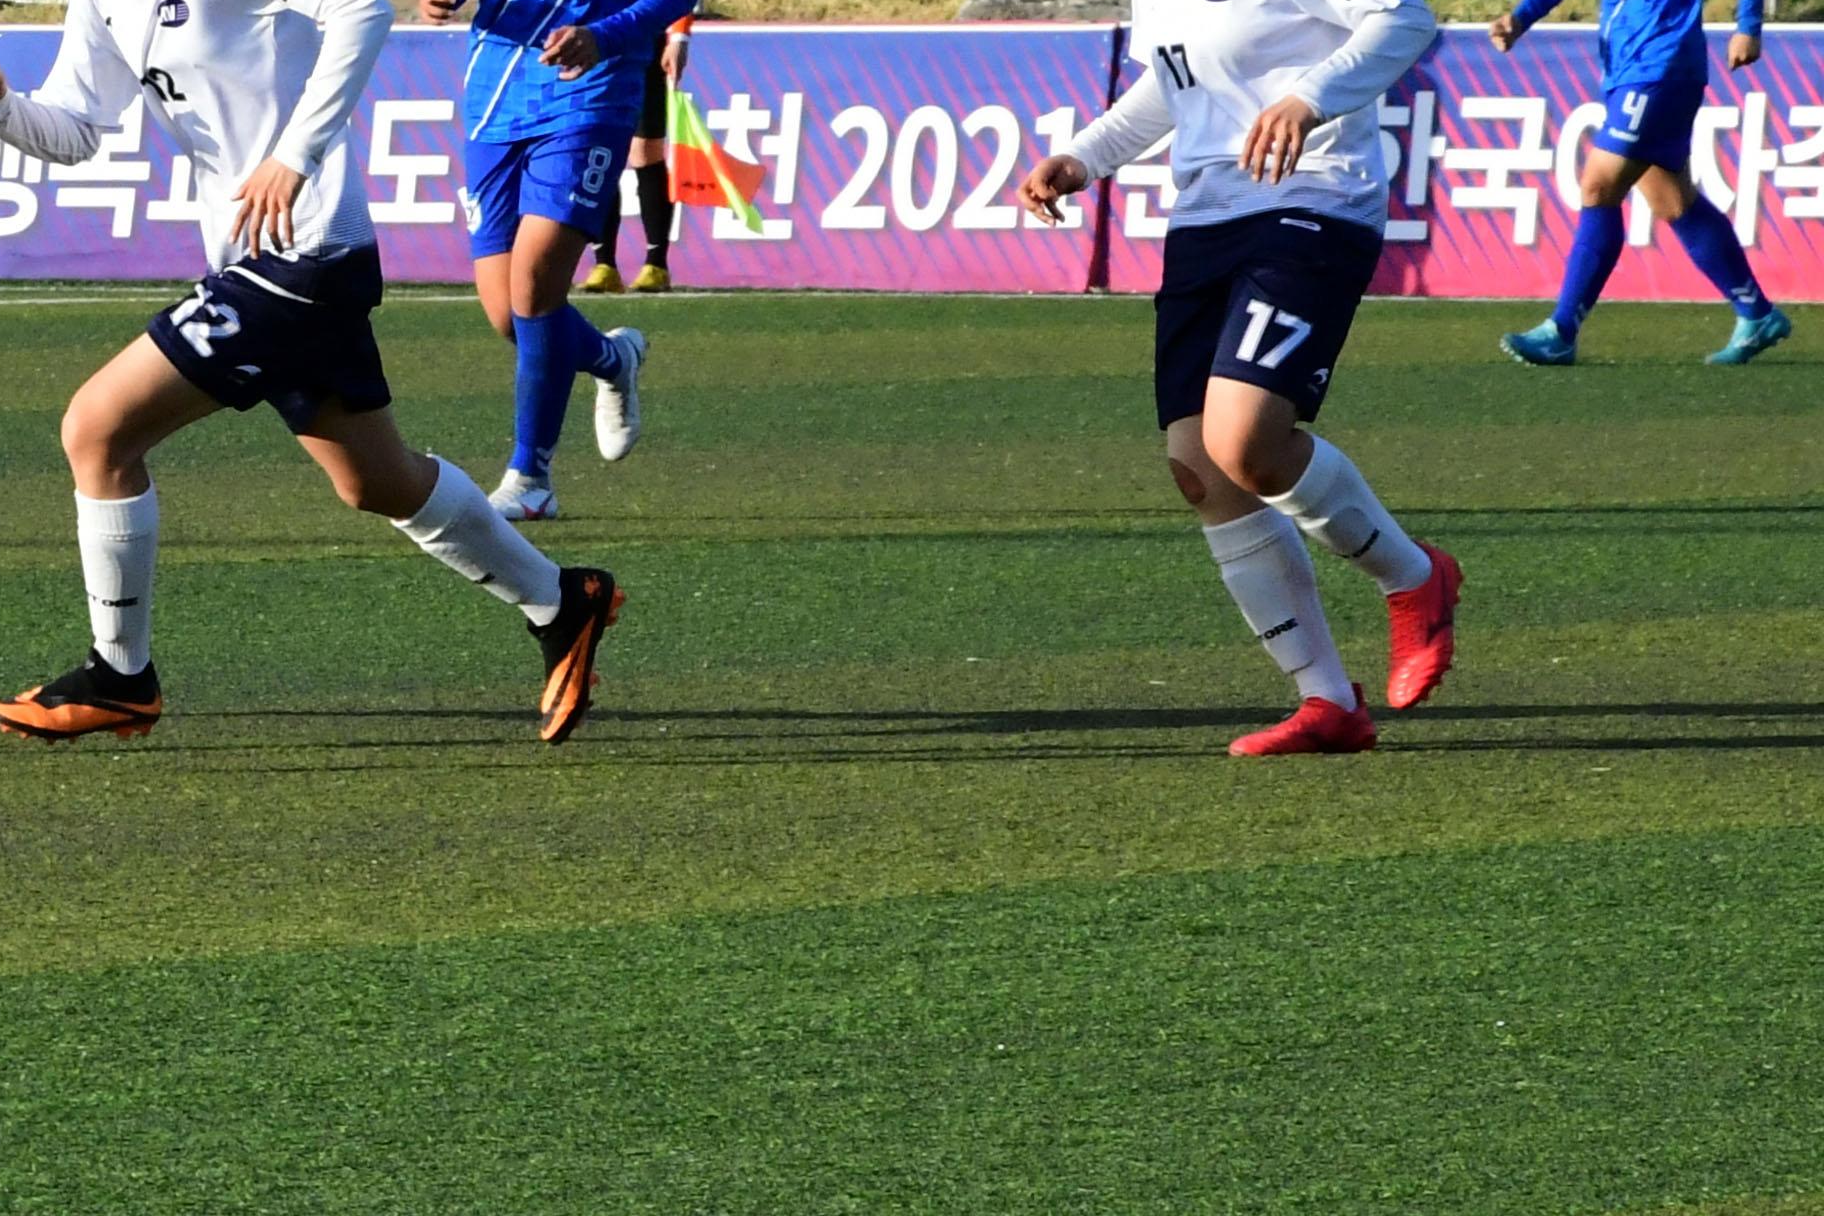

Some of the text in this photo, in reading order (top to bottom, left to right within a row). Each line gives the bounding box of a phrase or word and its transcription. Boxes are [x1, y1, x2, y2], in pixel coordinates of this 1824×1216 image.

[1157, 43, 1196, 90] 17
[1622, 91, 1649, 131] 4
[582, 146, 612, 194] 8
[1235, 299, 1312, 370] 17
